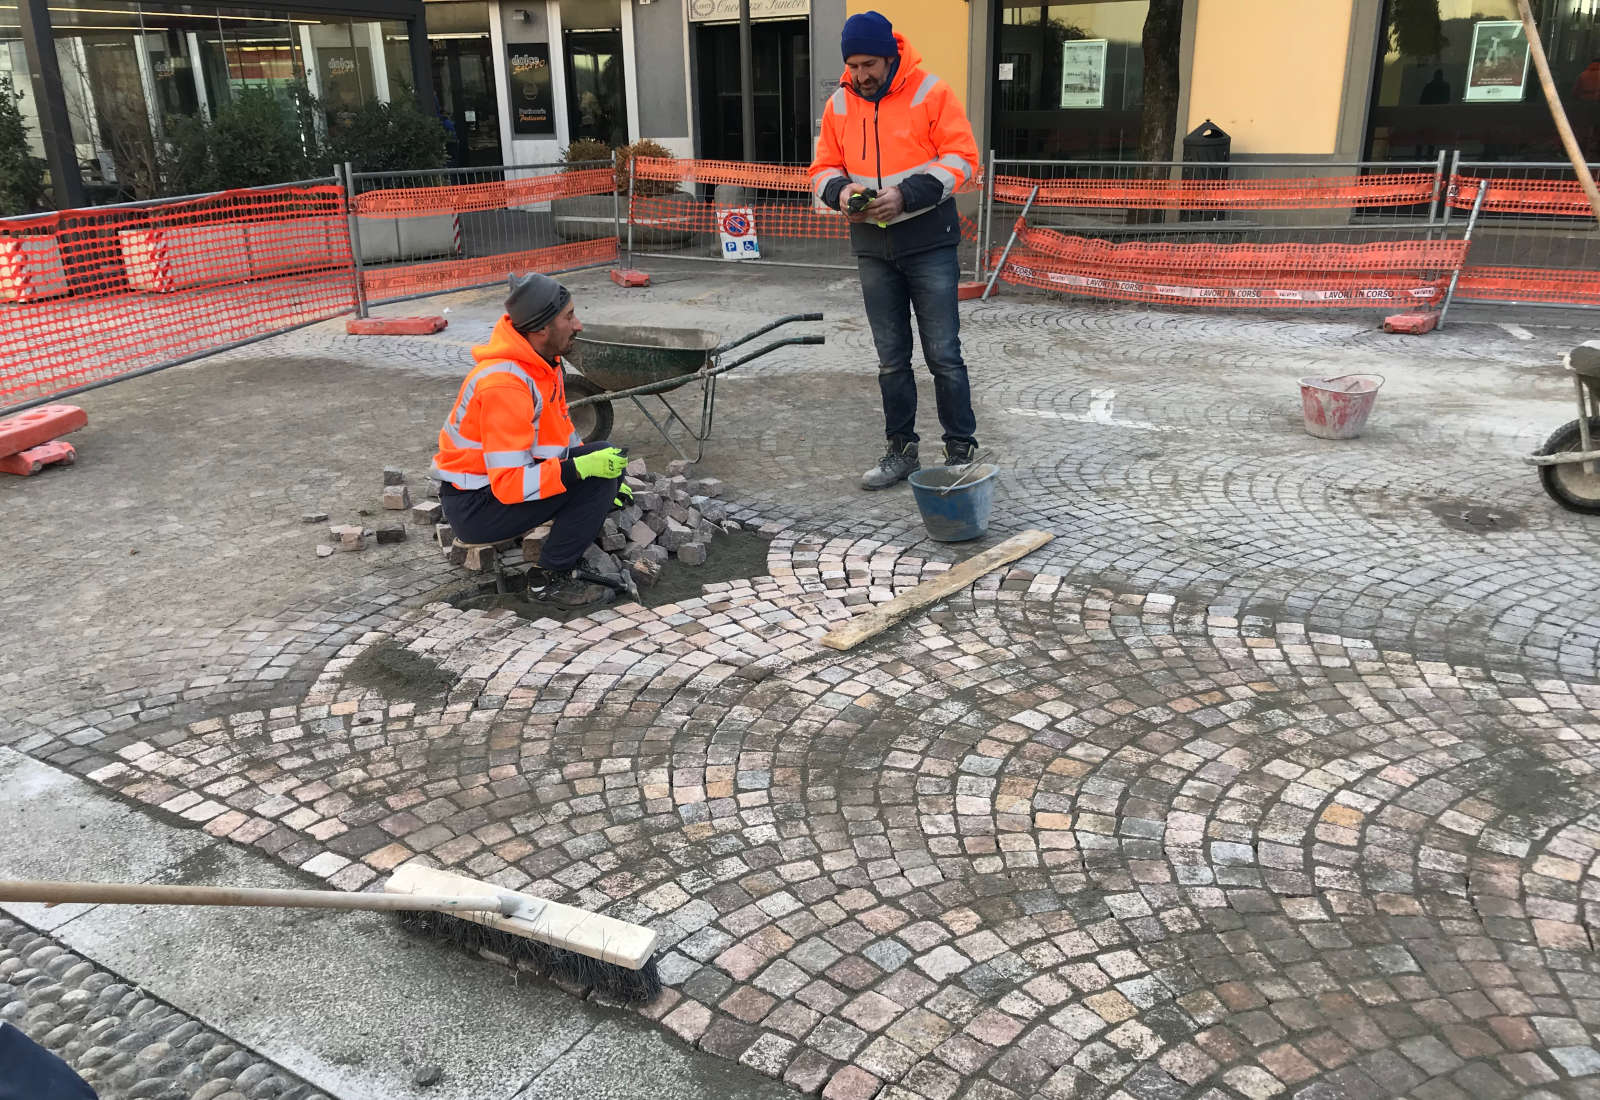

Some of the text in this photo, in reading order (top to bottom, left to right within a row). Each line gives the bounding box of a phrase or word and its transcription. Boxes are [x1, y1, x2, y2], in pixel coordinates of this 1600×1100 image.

[512, 54, 539, 65] dolce
[1086, 278, 1144, 291] LAVORI IN CORSO
[1199, 288, 1262, 298] LAVORI IN CORSO
[1323, 289, 1395, 299] LAVORI IN CORSO
